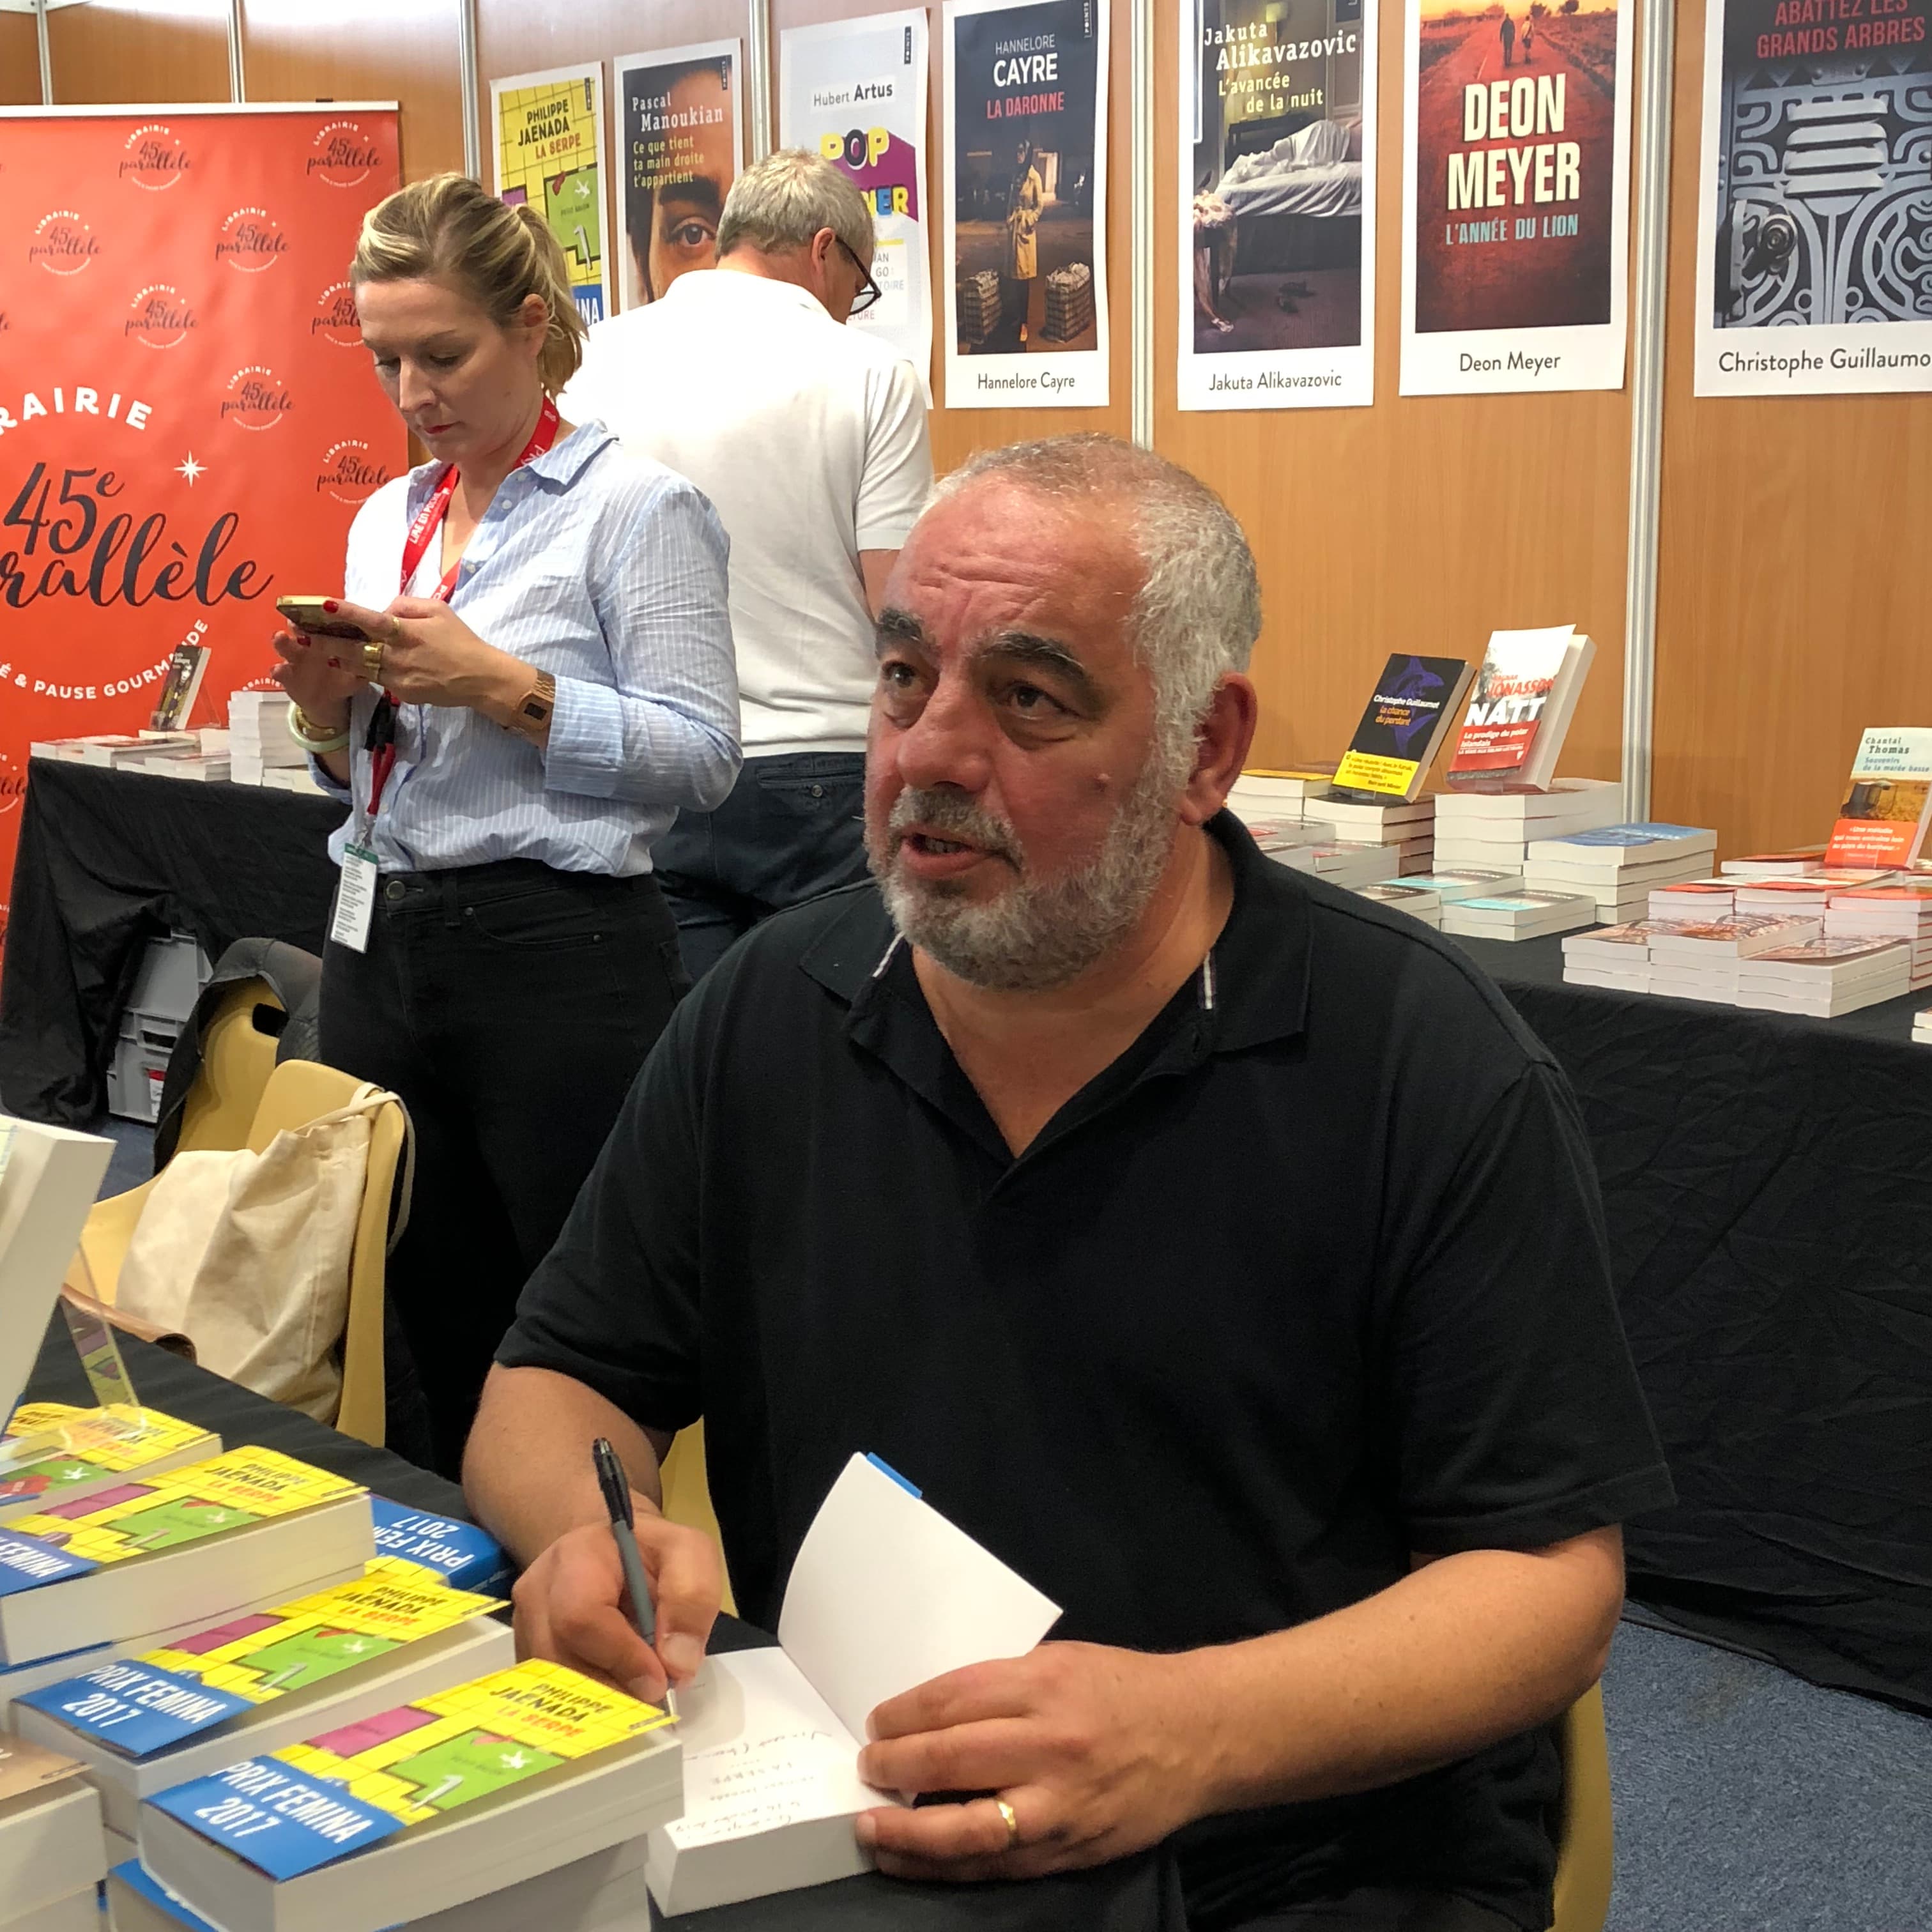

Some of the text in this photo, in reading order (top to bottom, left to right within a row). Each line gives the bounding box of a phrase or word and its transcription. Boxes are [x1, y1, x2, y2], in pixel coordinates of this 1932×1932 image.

[1775, 0, 1863, 26] ABATTEZ
[995, 33, 1055, 55] HANNELORE
[1204, 22, 1268, 46] Jakuta
[1757, 16, 1925, 59] GRANDS ARBRES
[1216, 29, 1356, 71] Alikavazovic
[993, 52, 1059, 87] CAYRE
[814, 83, 893, 107] Hubert Artus
[1218, 72, 1290, 96] L'avancée
[526, 98, 569, 125] PHILIPPE
[632, 91, 671, 112] Pascal
[986, 91, 1064, 119] LA DARONNE
[1246, 88, 1323, 113] de la nuit
[1464, 72, 1566, 142] DEON
[518, 116, 570, 146] JAENADA
[641, 105, 723, 132] Manoukian
[535, 133, 581, 160] LA SERPE
[633, 135, 694, 155] Ce que tient
[820, 126, 890, 170] POP
[634, 152, 704, 172] ta main droite
[634, 170, 693, 189] t'appartient
[1448, 142, 1581, 210] MEYER
[1445, 213, 1579, 245] L'ANNÉE DU LION
[1460, 351, 1561, 376] Deon Meyer
[1719, 348, 1931, 378] Christophe Guillaumo
[977, 371, 1075, 394] Hannelore Cayre
[1209, 369, 1342, 390] Jakuta Alikavazovic
[14, 673, 27, 688] &
[34, 680, 96, 700] PAUSE
[103, 619, 208, 697] GOURMDE
[1869, 745, 1910, 754] Thomas
[204, 1466, 288, 1491] JAENADA
[390, 1515, 460, 1539] 2017
[405, 1539, 475, 1568] PRIX
[332, 1591, 425, 1614] JAENADA
[75, 1665, 228, 1724] PRIX FEMINA
[489, 1686, 589, 1722] JAENADA
[531, 1683, 614, 1713] PHILIPPE
[62, 1693, 144, 1728] 2017
[208, 1761, 374, 1843] PRIX FEMINA
[194, 1797, 283, 1837] 2017
